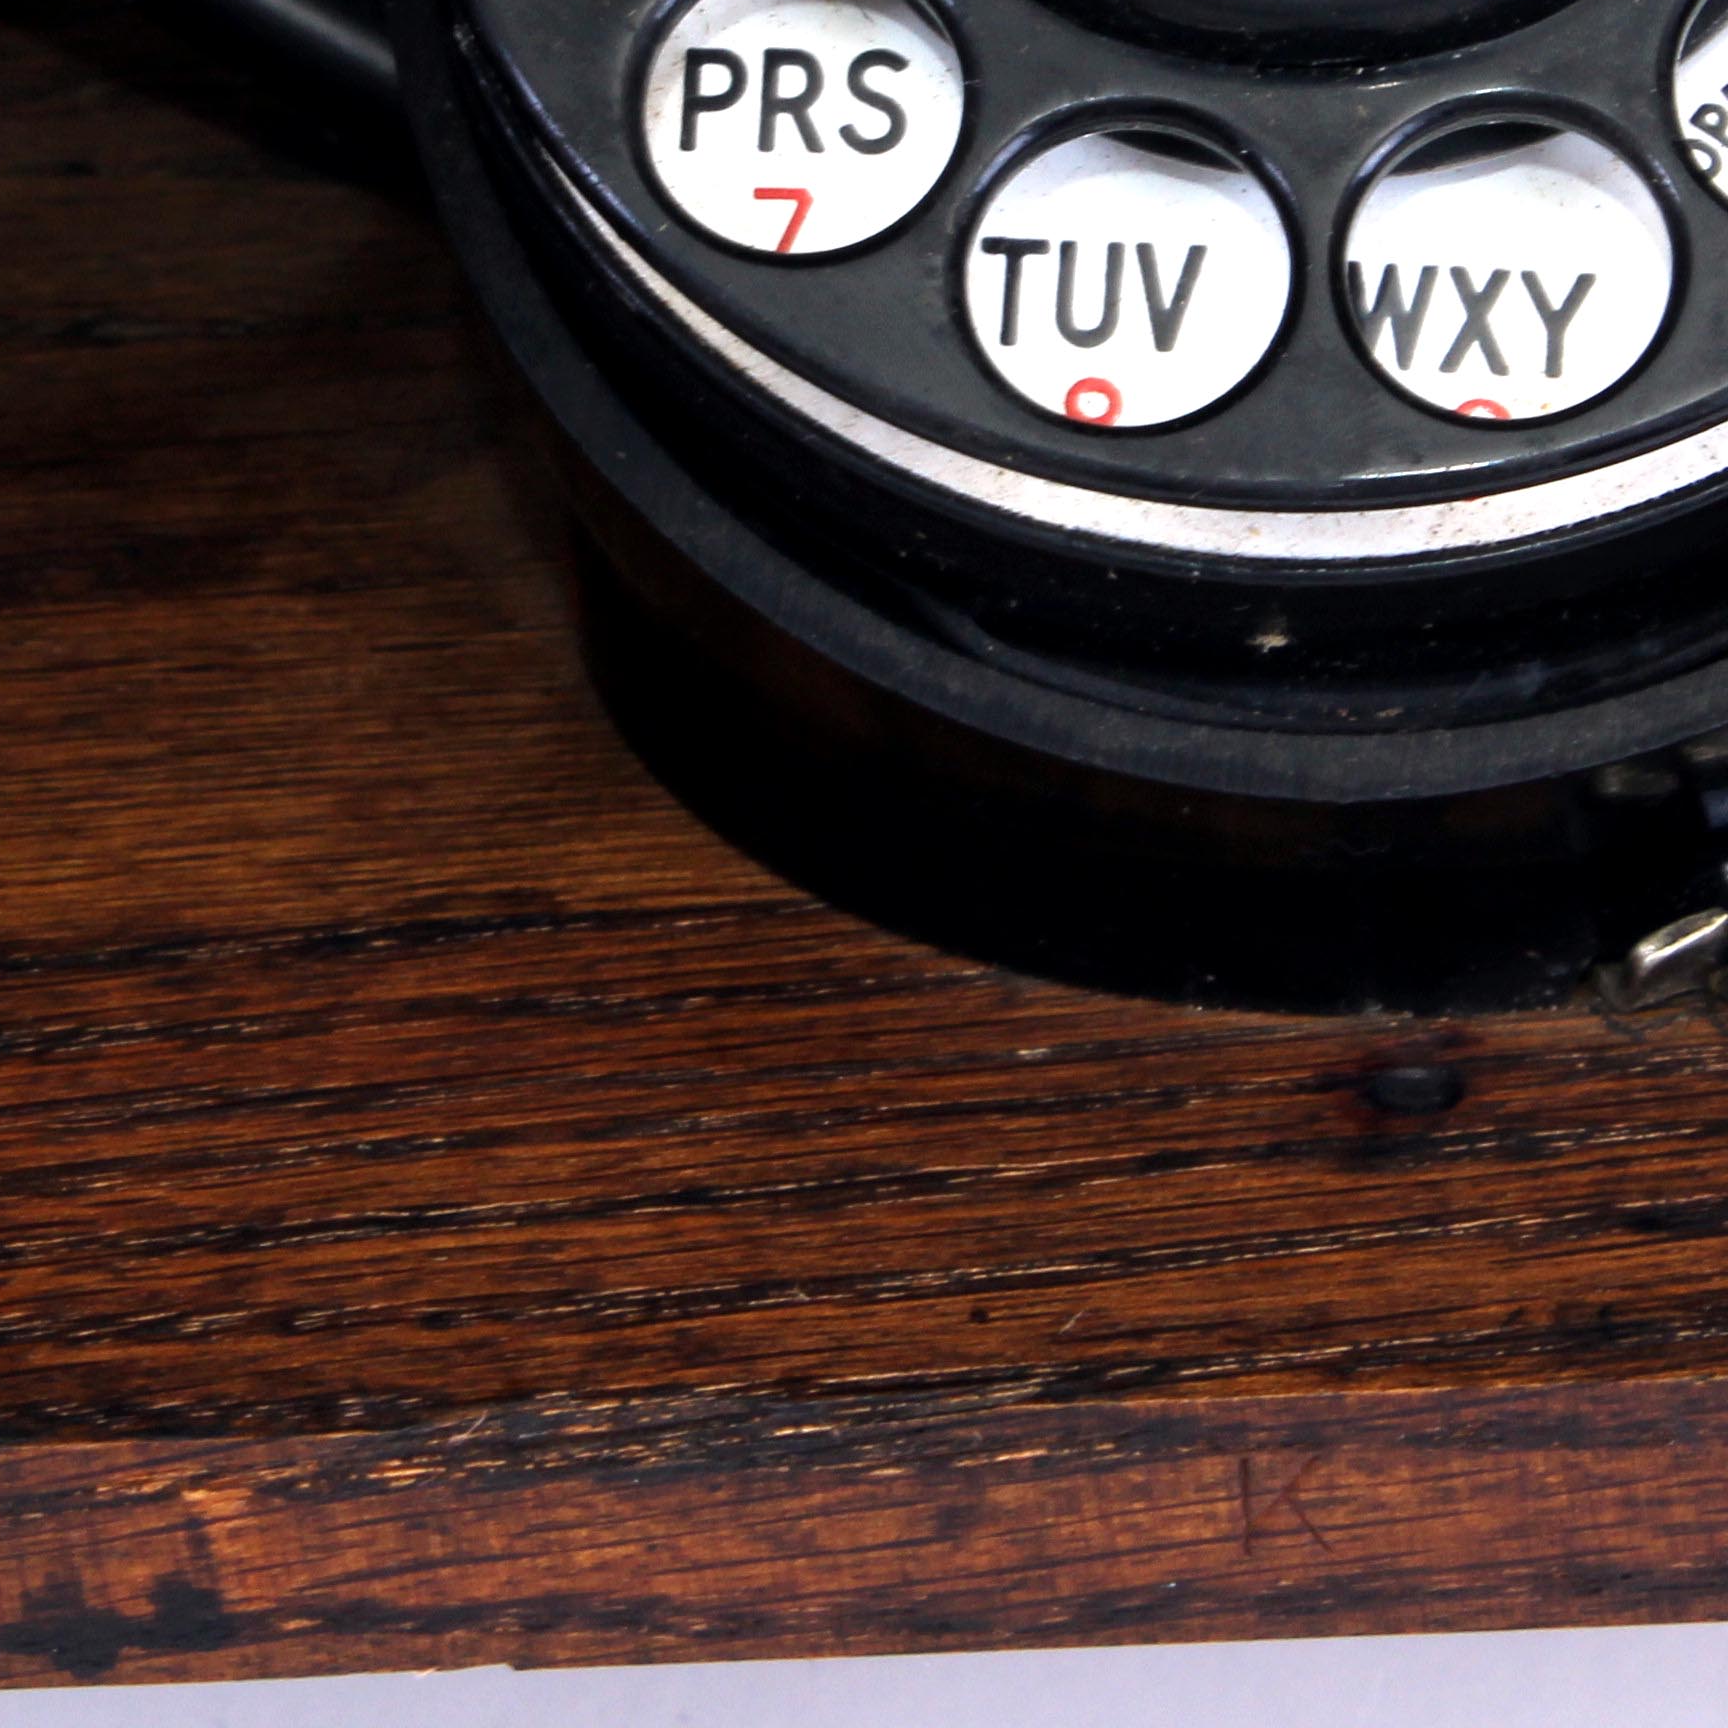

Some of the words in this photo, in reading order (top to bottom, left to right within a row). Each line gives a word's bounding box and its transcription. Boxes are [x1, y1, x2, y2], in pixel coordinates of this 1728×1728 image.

[679, 47, 909, 155] PRS
[753, 187, 813, 253] 7
[981, 237, 1207, 352] TUV
[1347, 260, 1595, 377] WXY
